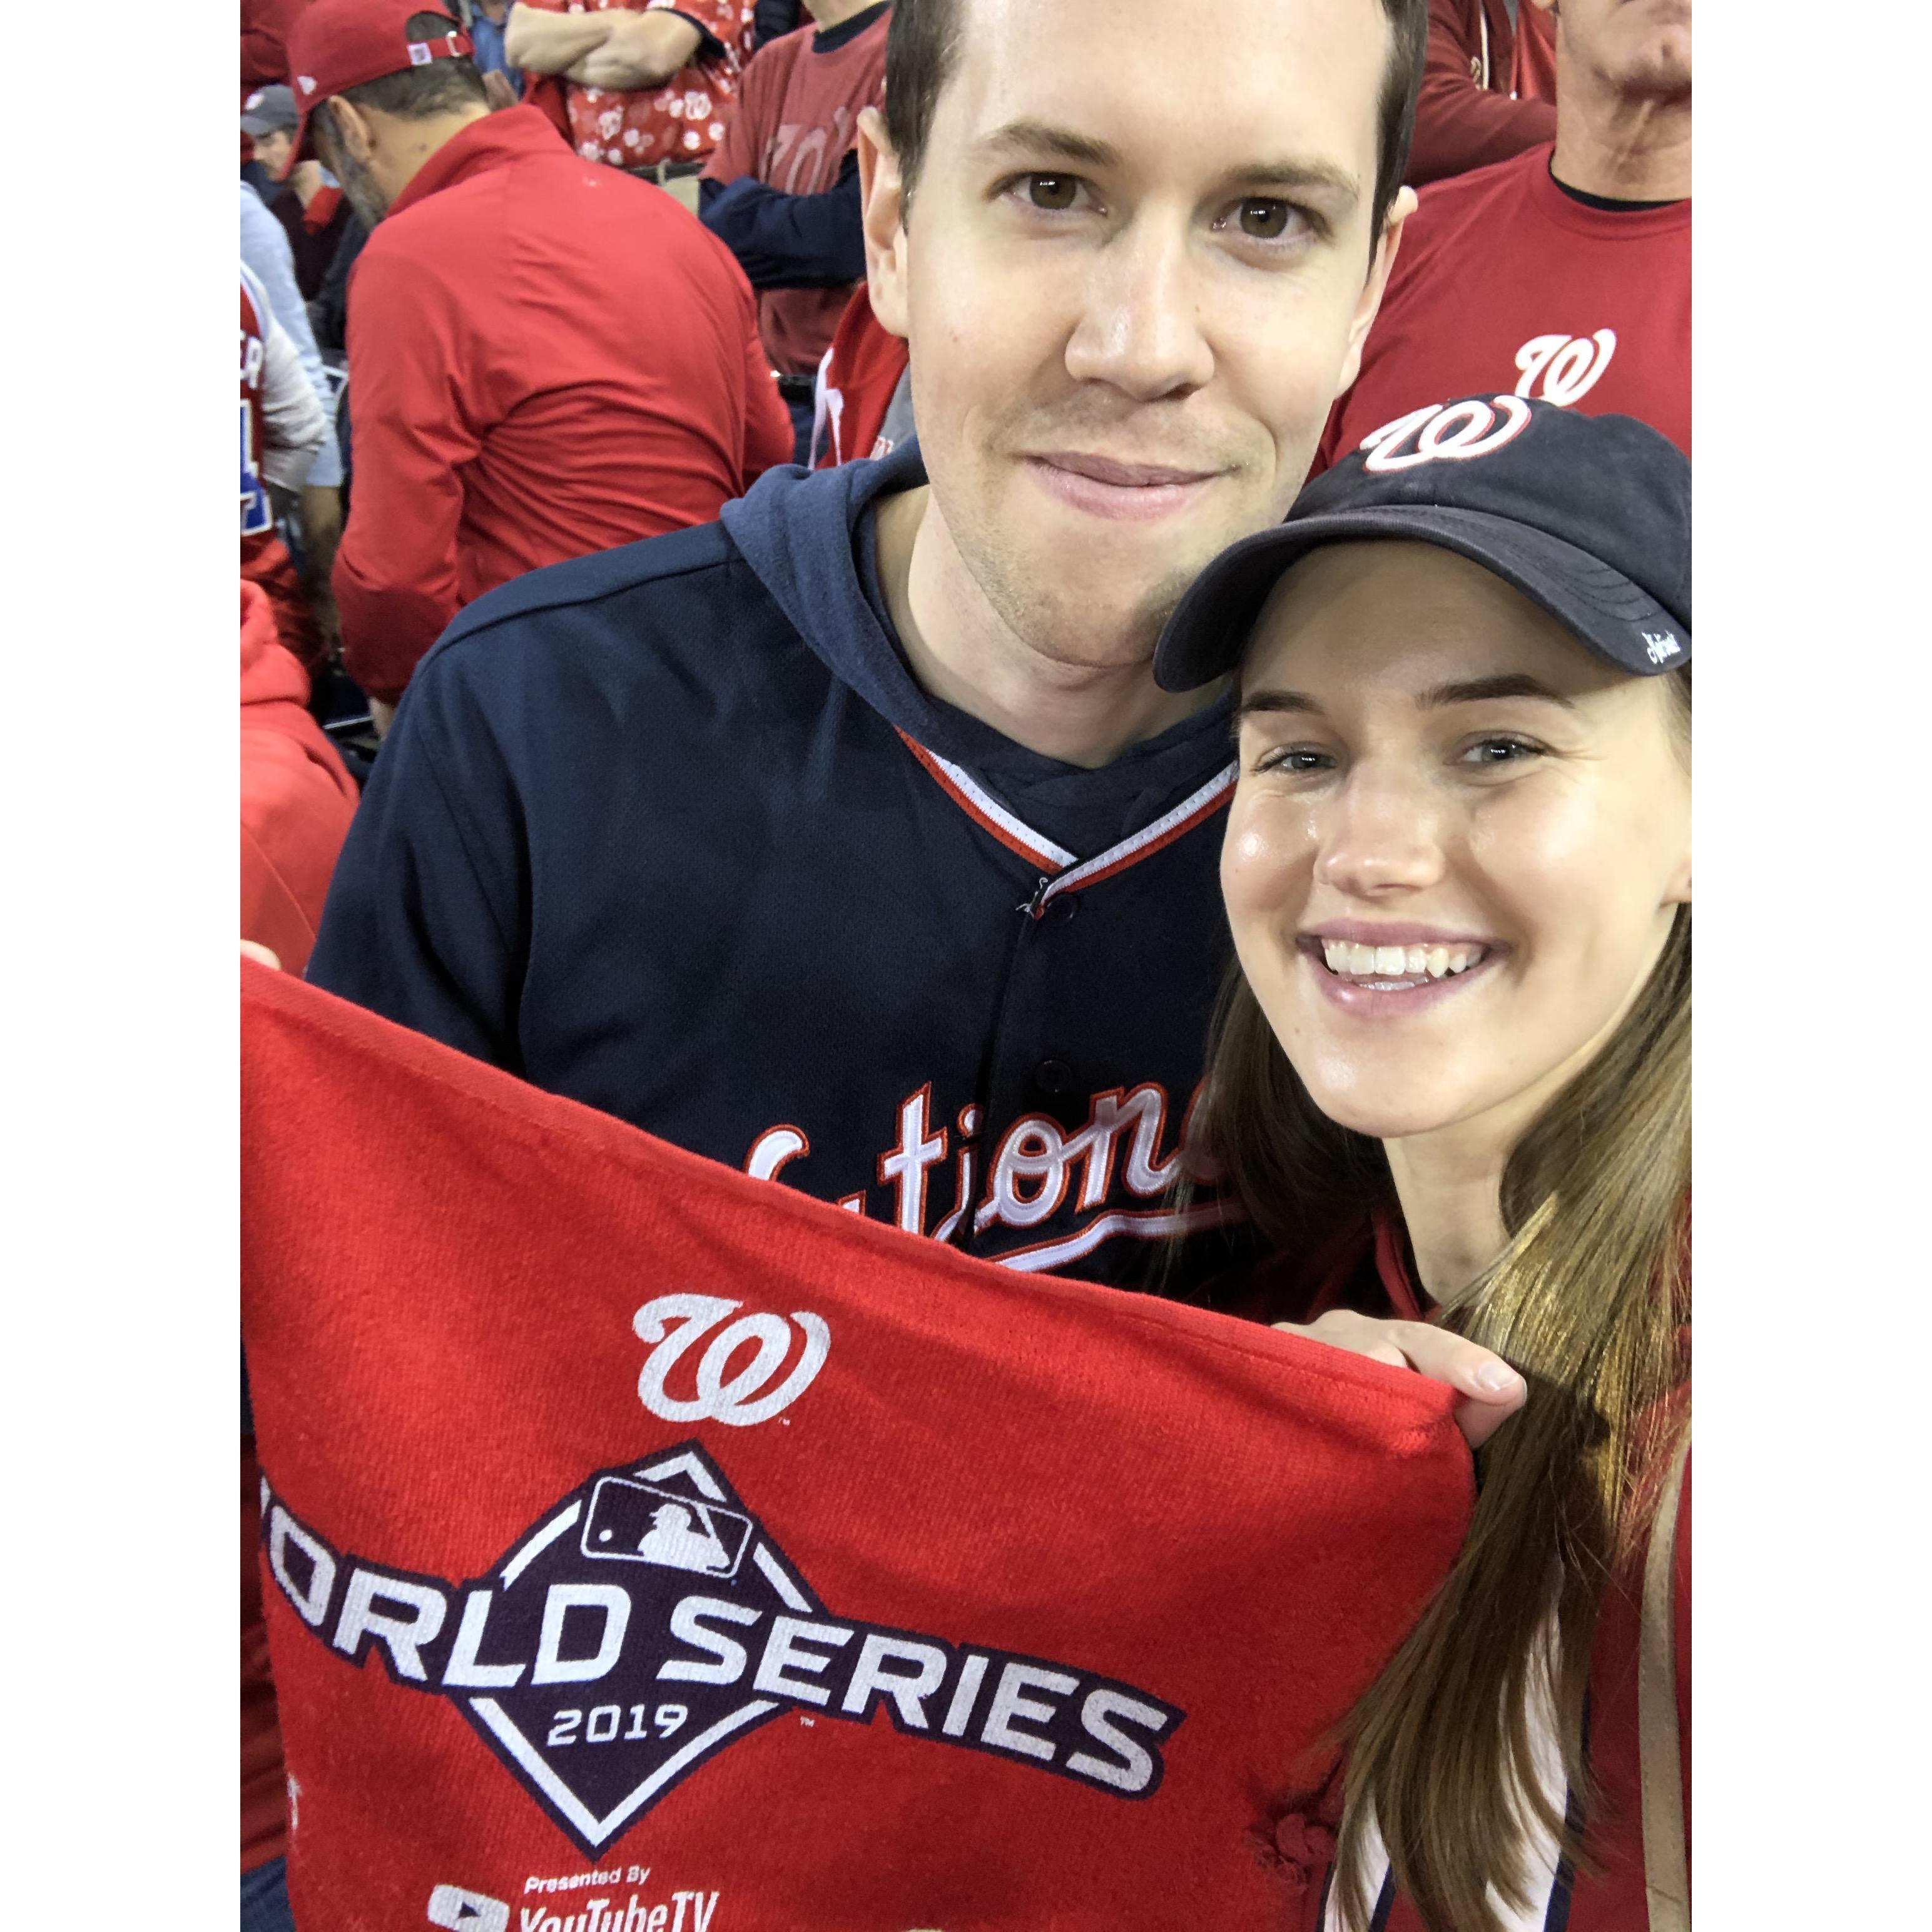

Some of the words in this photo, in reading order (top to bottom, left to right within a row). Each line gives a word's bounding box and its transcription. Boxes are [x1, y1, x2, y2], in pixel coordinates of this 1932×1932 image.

[1514, 328, 1617, 407] W
[1358, 394, 1532, 472] W
[633, 1292, 831, 1426] W
[260, 1475, 631, 1687] ORLD
[656, 1595, 1168, 1792] SERIES
[547, 1704, 689, 1746] 2019
[524, 1867, 622, 1894] Presented
[626, 1864, 651, 1885] By
